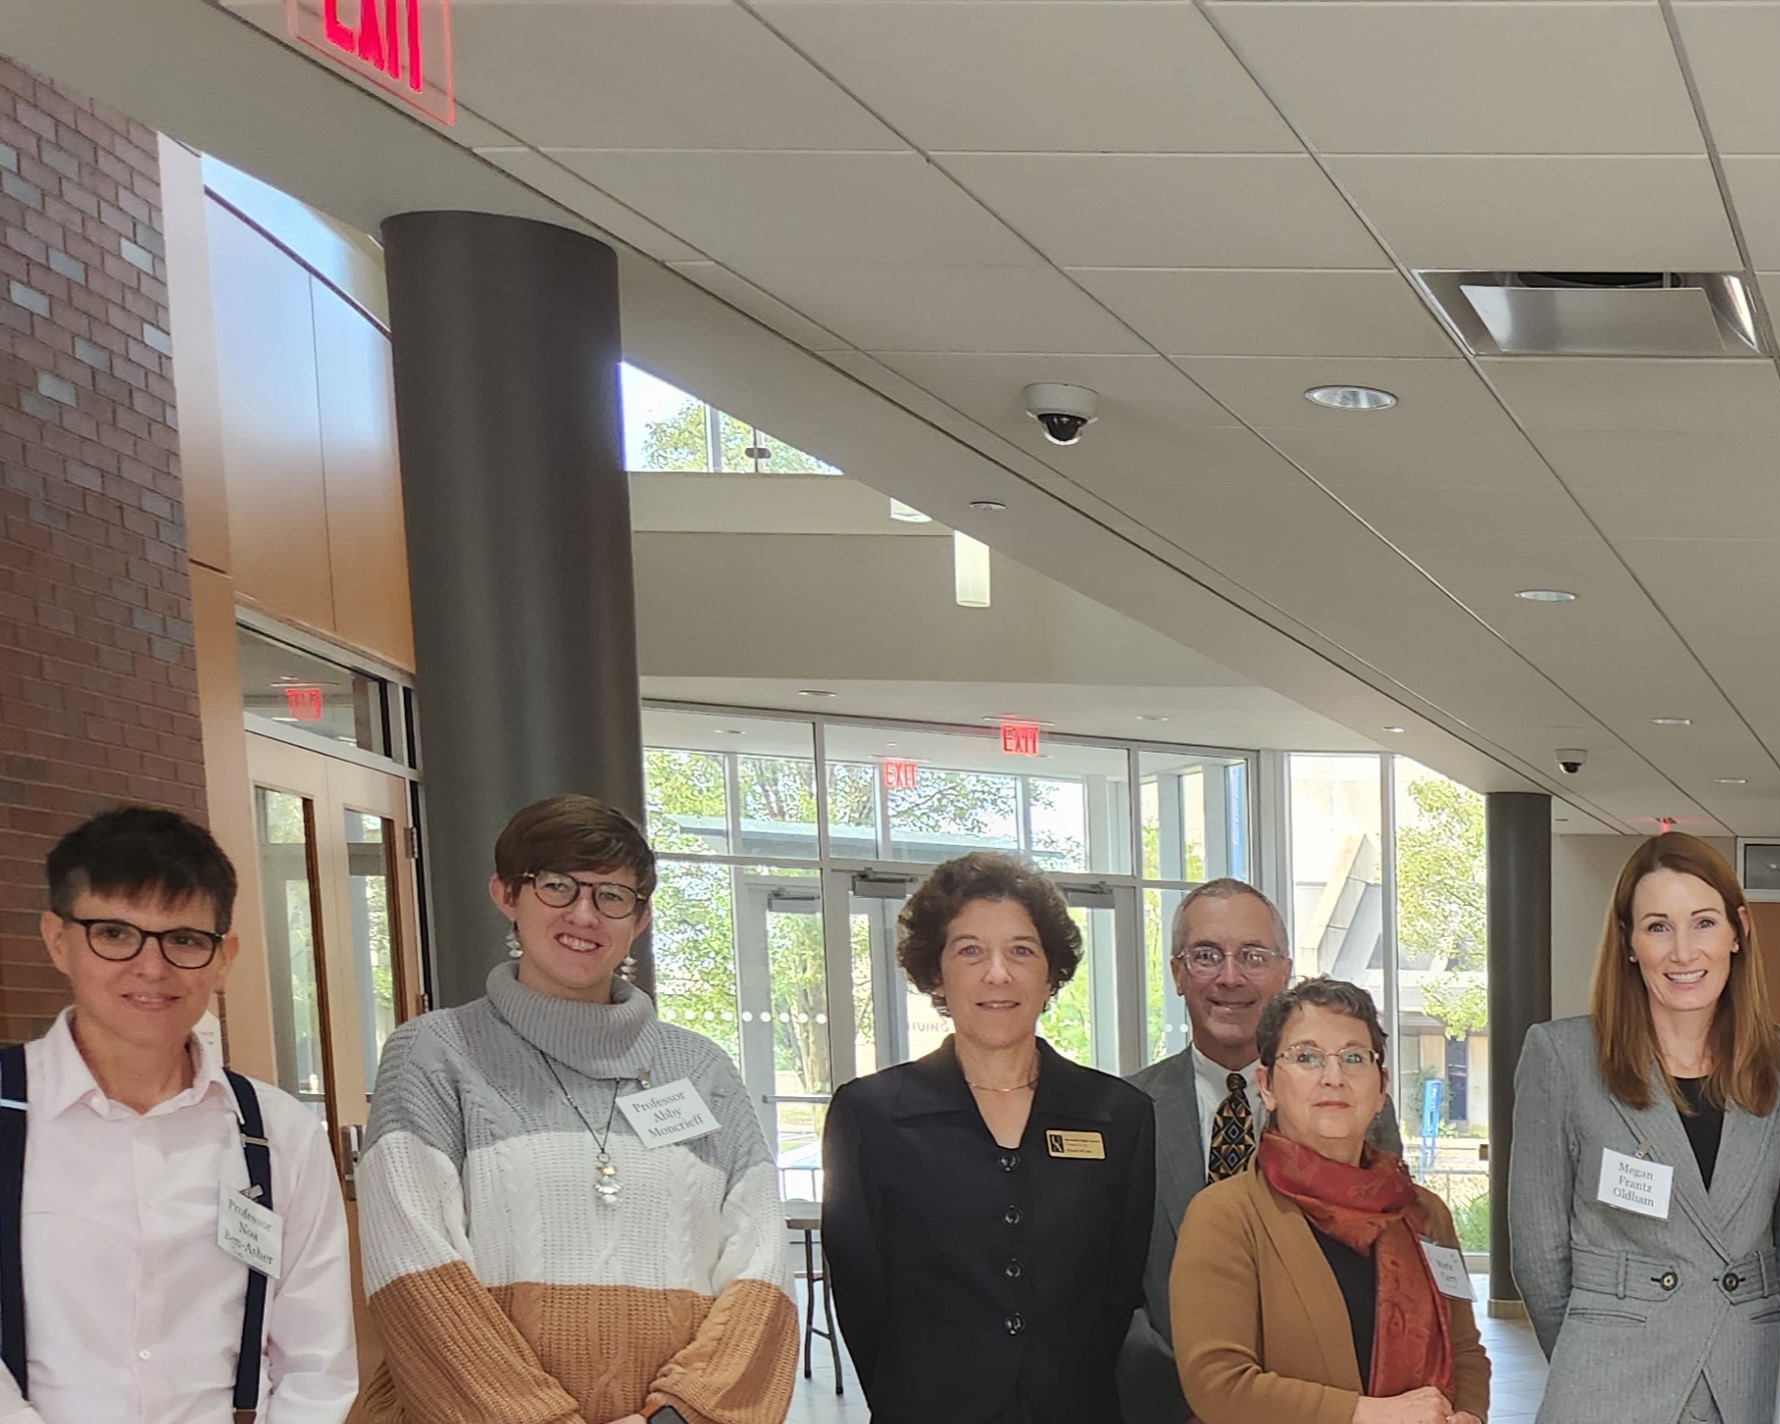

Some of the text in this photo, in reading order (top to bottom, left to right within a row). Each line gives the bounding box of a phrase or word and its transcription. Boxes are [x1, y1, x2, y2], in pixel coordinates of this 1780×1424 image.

[1003, 726, 1038, 755] EXIT
[885, 762, 917, 788] EXIT
[632, 1092, 686, 1113] Professor
[648, 1113, 704, 1138] Moncrieff
[654, 1108, 682, 1123] Abby
[1618, 1161, 1654, 1181] Megan
[1619, 1175, 1653, 1194] Frantz
[1613, 1187, 1654, 1207] Oldham
[228, 1198, 272, 1232] Professor
[239, 1220, 259, 1241] Noa
